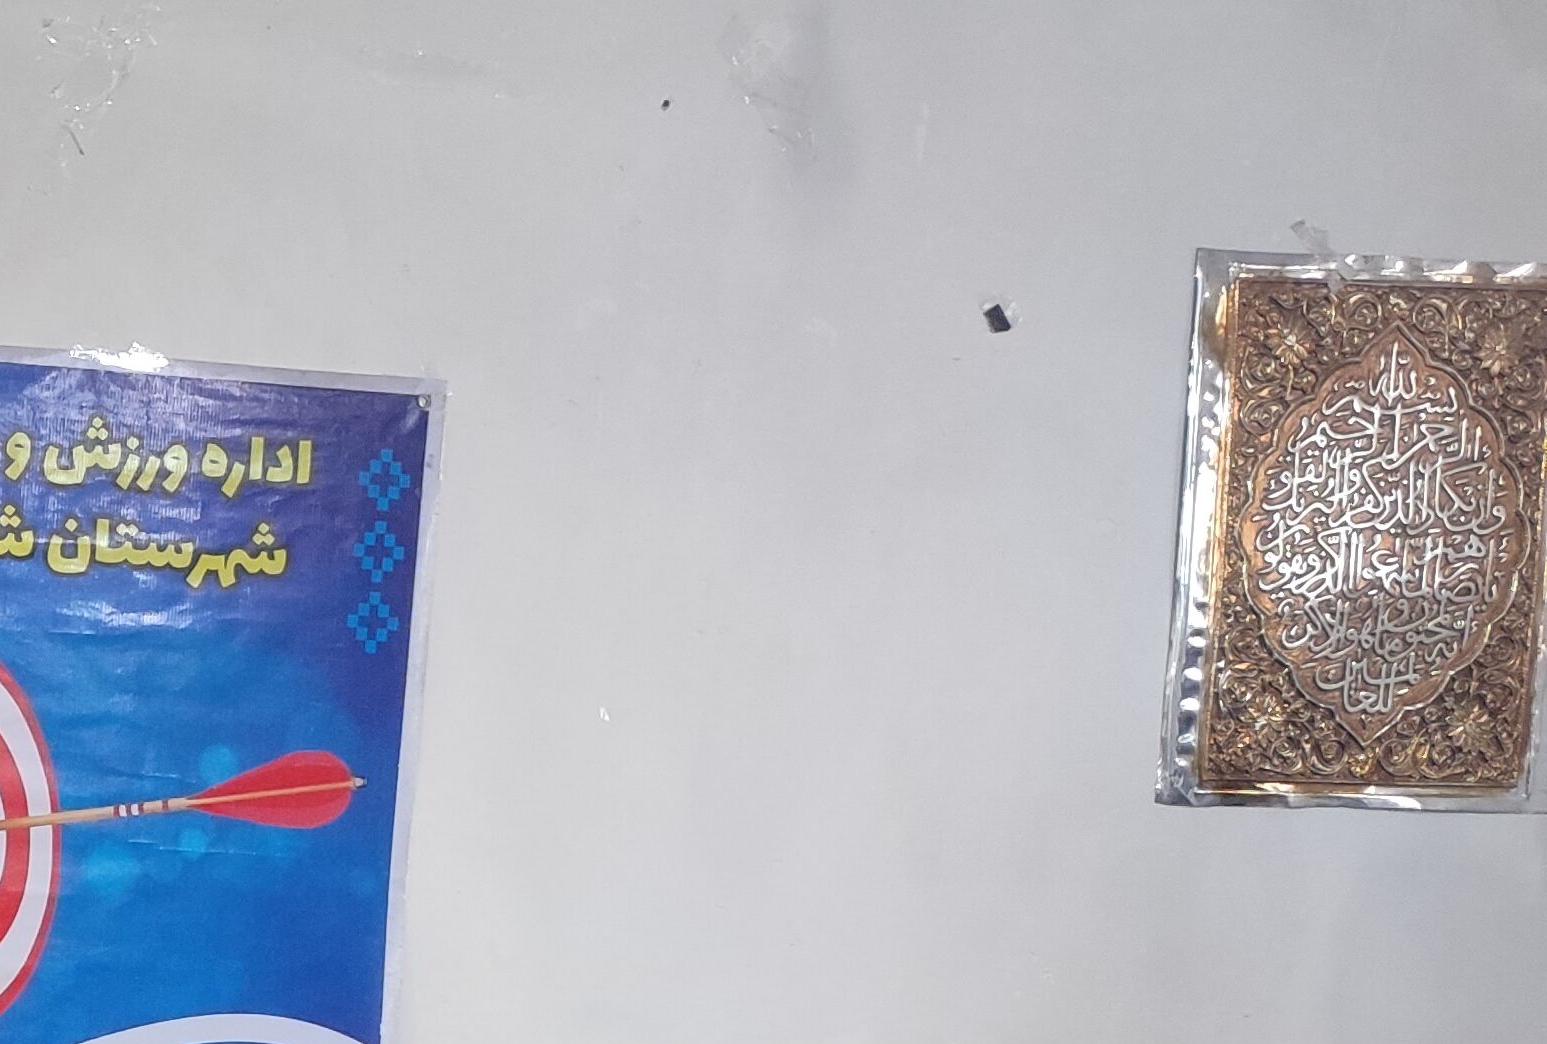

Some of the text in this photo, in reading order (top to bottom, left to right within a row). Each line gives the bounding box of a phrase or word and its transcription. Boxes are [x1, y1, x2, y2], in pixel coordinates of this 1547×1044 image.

[5, 438, 30, 480] و
[44, 417, 188, 491] ورزش
[201, 438, 313, 496] اداره
[47, 514, 286, 587] شهرستان
